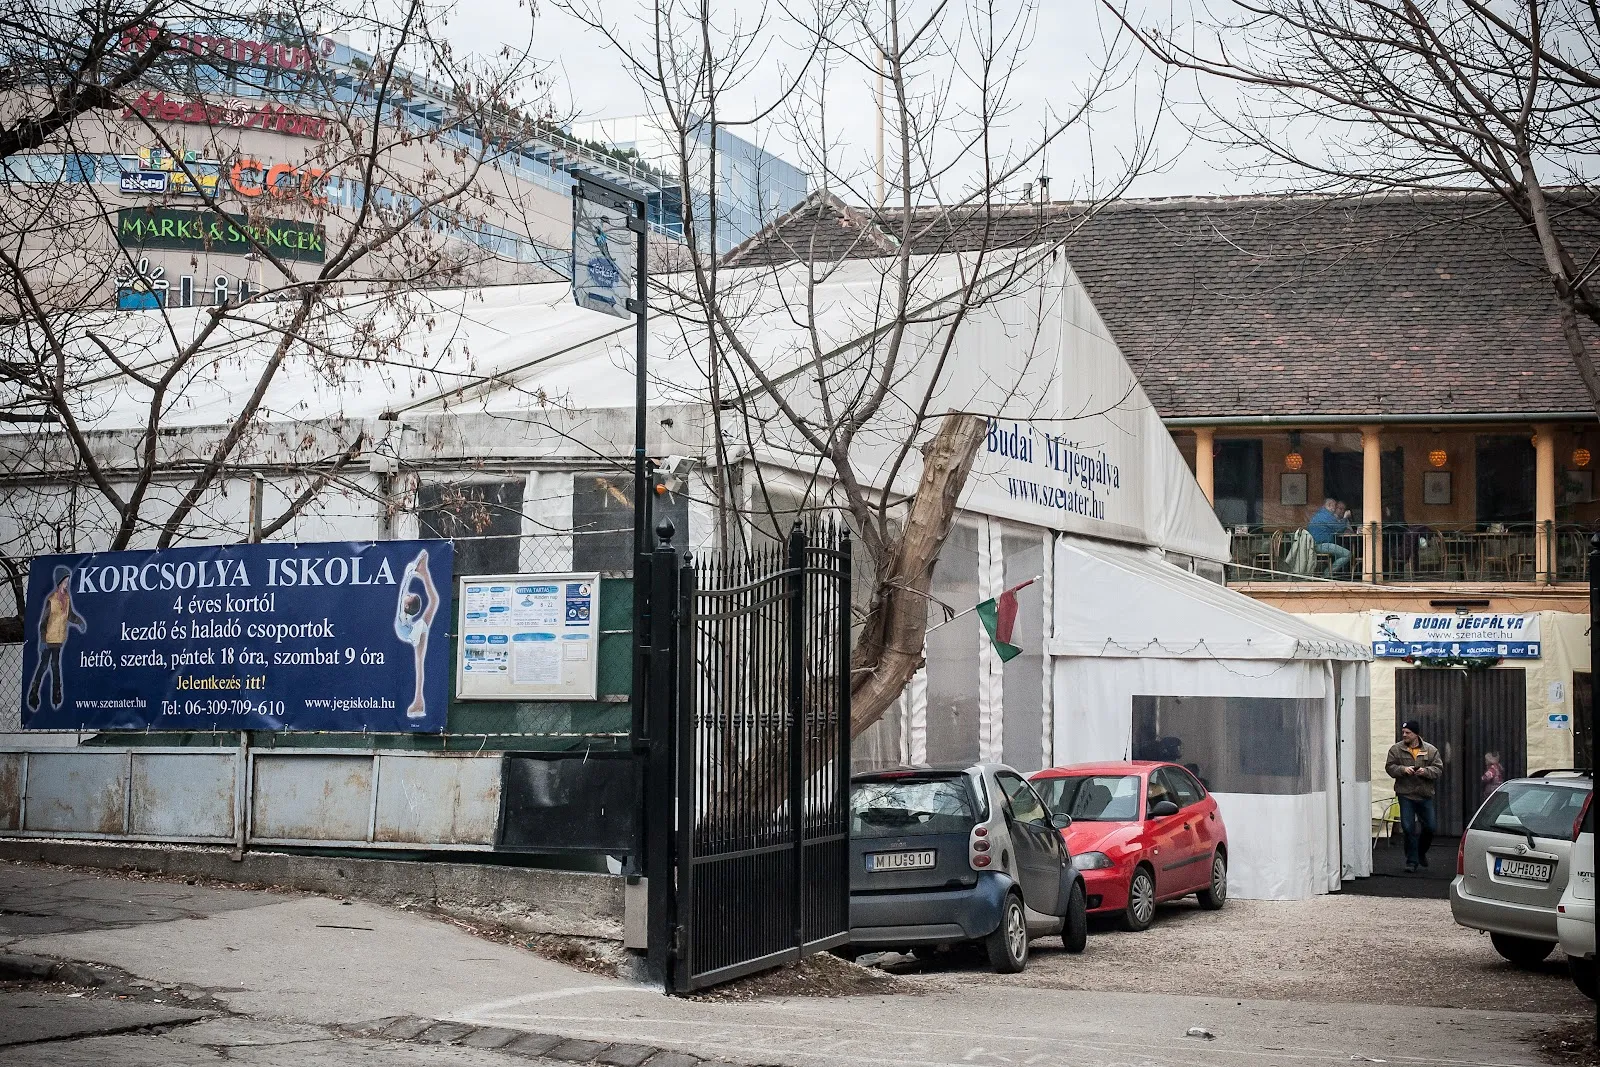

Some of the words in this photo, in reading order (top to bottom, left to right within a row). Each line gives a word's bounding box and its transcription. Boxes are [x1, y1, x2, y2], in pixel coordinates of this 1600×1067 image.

[121, 218, 202, 239] MARKS
[208, 222, 224, 241] &
[987, 416, 1033, 464] Budai
[77, 559, 250, 594] KORCSOLYA
[266, 556, 397, 586] ISKOLA
[173, 595, 183, 614] 4
[188, 594, 221, 614] éves
[225, 593, 275, 613] kortól
[121, 621, 166, 641] kezdő
[170, 621, 187, 639] és
[191, 618, 242, 639] haladó
[247, 618, 335, 641] csoportok
[1413, 618, 1452, 629] BUDAI
[1456, 615, 1524, 629] JÉGPÁLYA
[1427, 630, 1513, 639] www.szenater.hu
[80, 650, 117, 670] hétfő,
[120, 649, 168, 669] szerda,
[171, 648, 215, 671] péntek
[220, 647, 235, 665] 18
[239, 647, 269, 667] óra,
[273, 647, 340, 665] szombat
[345, 647, 356, 665] 9
[360, 647, 385, 665] óra
[176, 674, 241, 690] Jelentkezés
[245, 674, 266, 690] itt!
[75, 697, 147, 709] www.szenater.hu
[161, 700, 181, 715] Tel:
[184, 700, 285, 716] 06-309-709-610
[304, 696, 395, 712] www.jegiskola.hu
